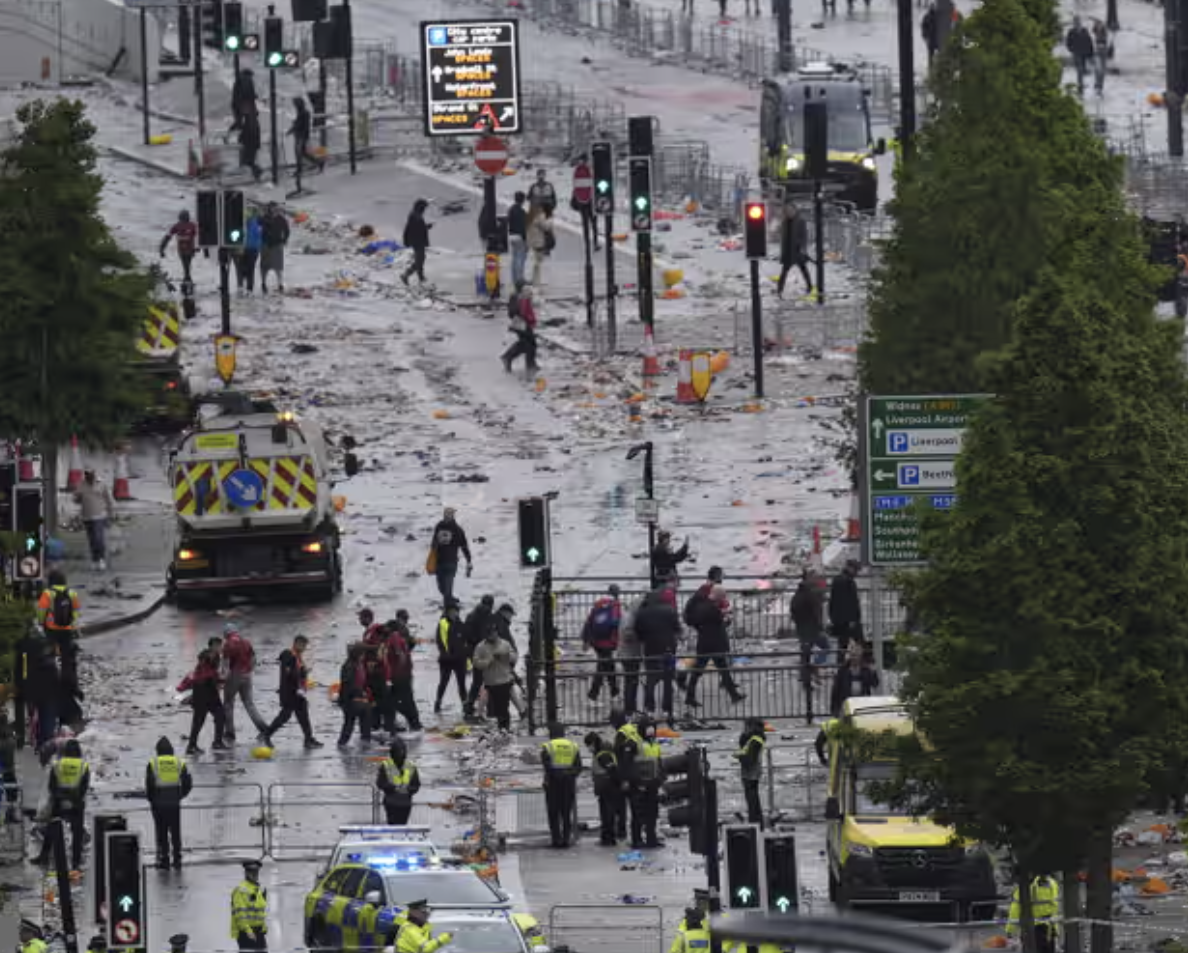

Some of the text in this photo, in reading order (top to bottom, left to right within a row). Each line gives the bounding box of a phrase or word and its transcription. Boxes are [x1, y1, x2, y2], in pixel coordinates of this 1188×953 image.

[885, 401, 921, 411] Widnes
[885, 414, 931, 425] Liverpool
[893, 434, 906, 451] P
[910, 436, 958, 447] Liverpool
[904, 468, 917, 483] P
